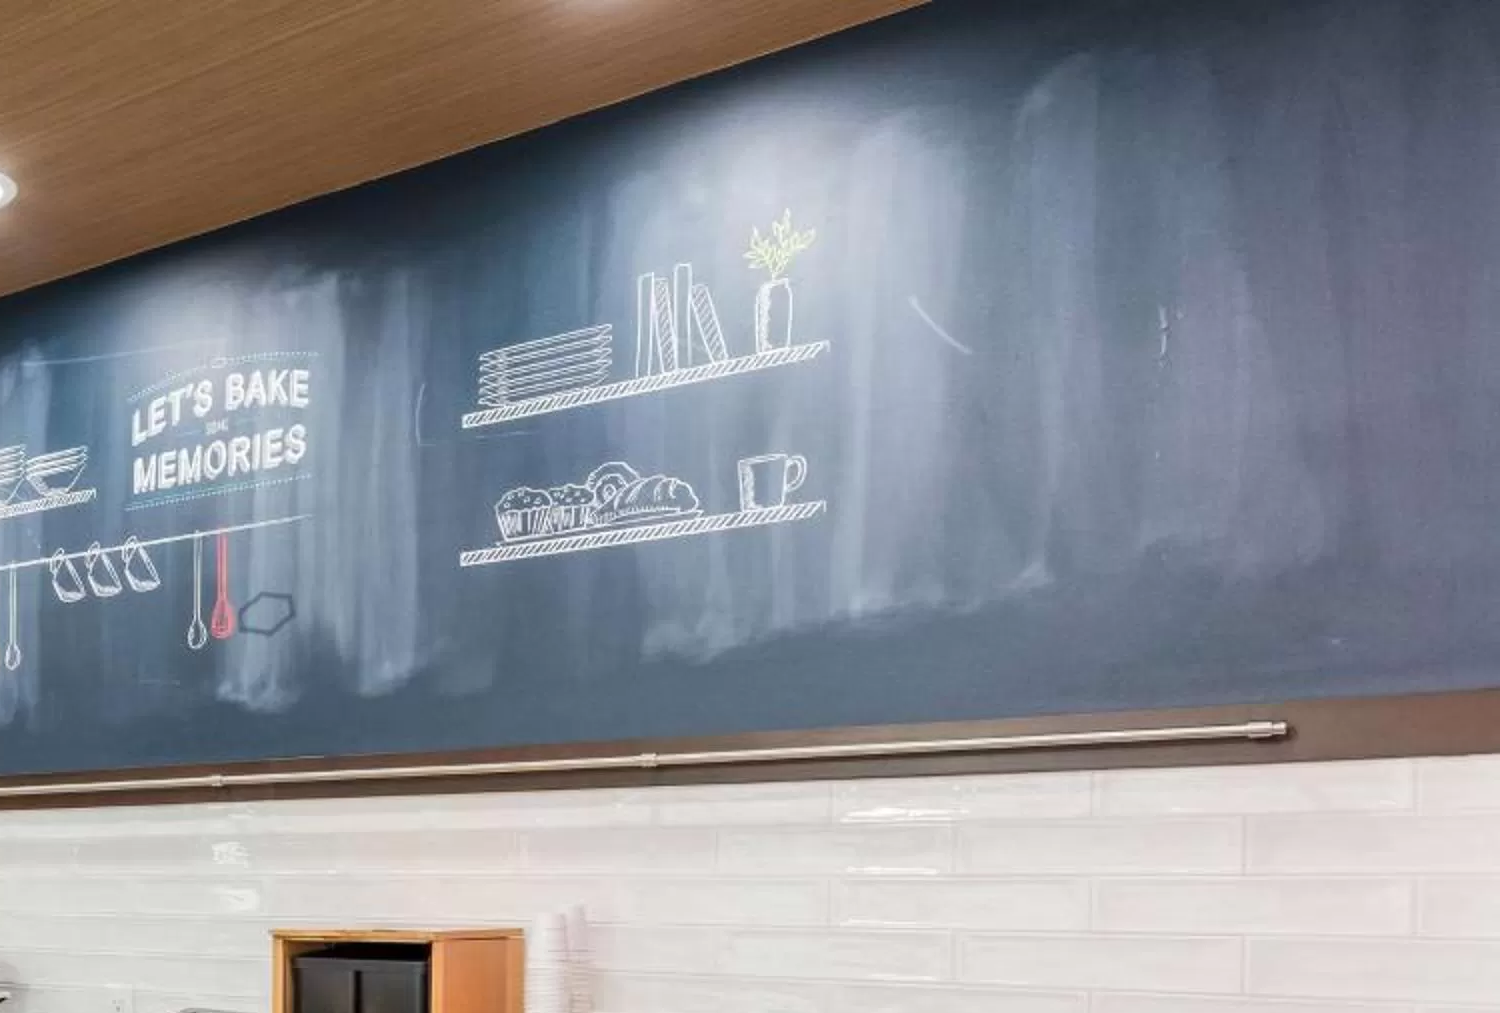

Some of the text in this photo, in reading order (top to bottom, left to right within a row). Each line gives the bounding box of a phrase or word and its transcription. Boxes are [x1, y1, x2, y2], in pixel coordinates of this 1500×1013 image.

[131, 368, 309, 447] LET'S BAKE
[133, 423, 307, 494] MEMORIES
